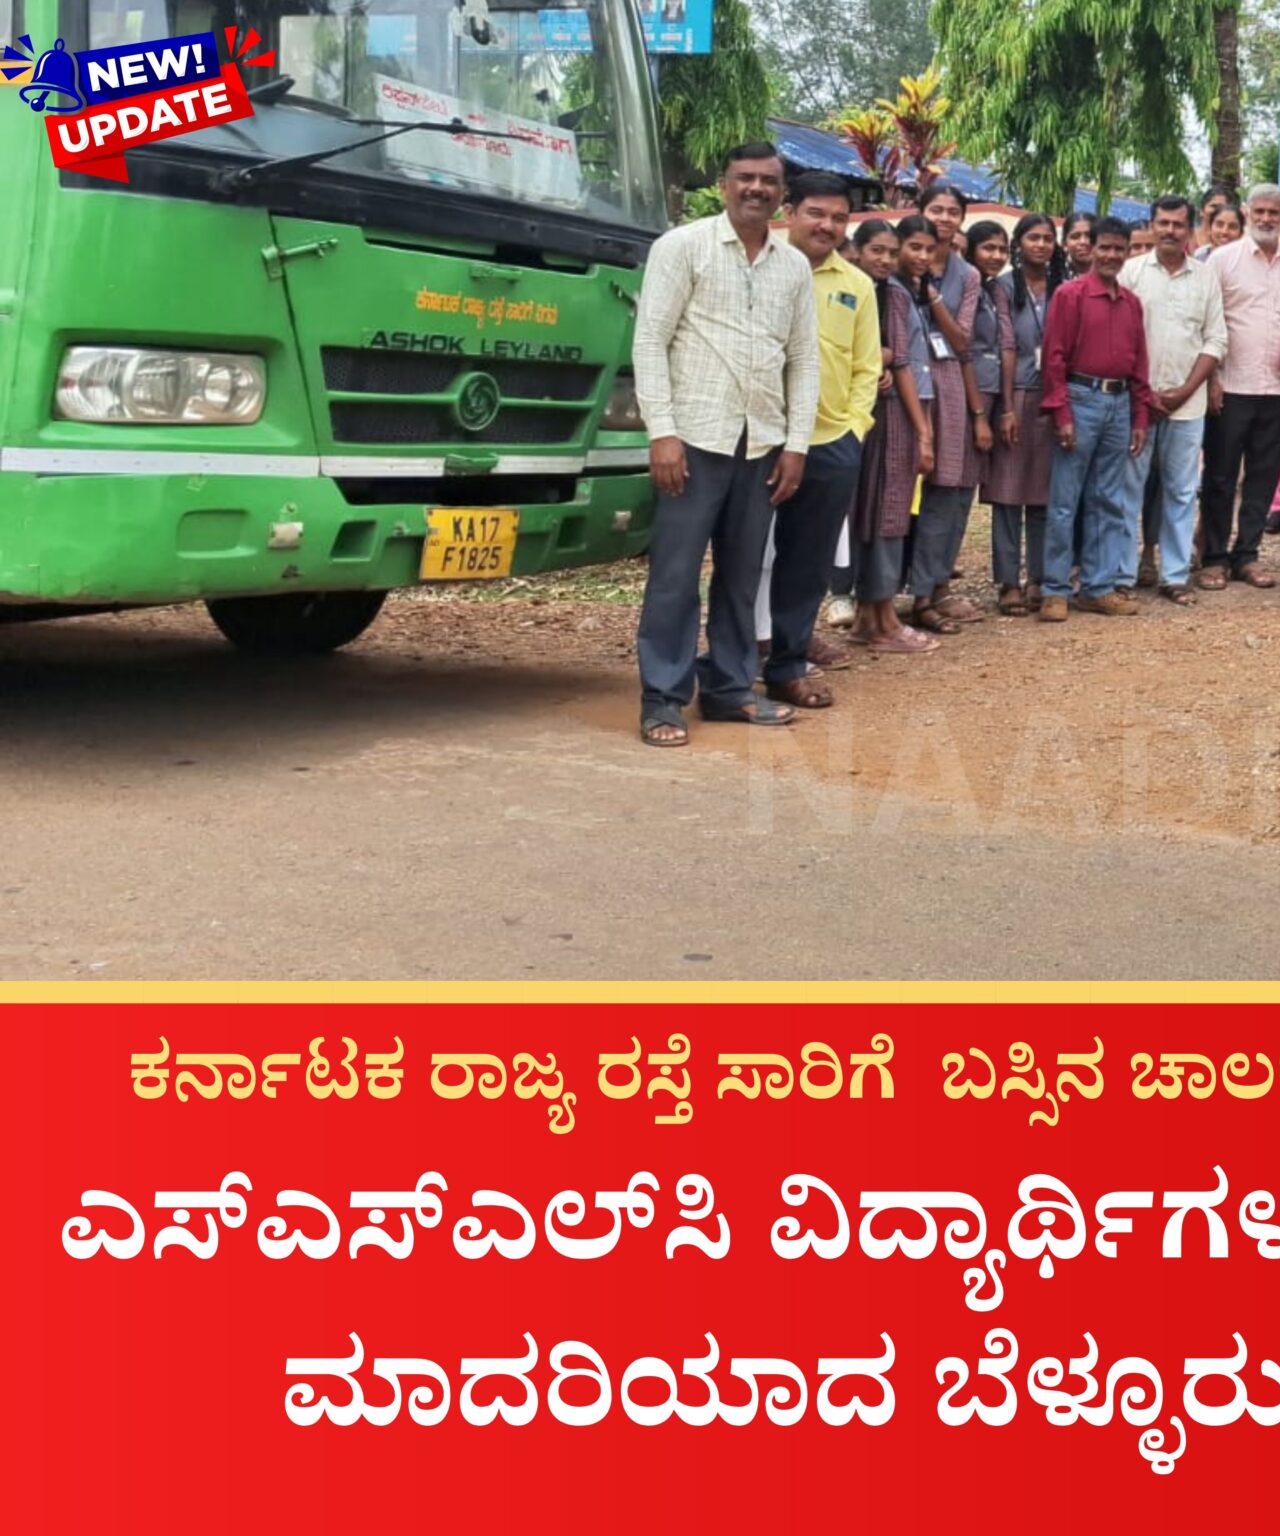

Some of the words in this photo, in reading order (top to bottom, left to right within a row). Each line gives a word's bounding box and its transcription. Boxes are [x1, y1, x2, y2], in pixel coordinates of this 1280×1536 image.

[369, 330, 466, 354] ASHOK
[480, 338, 583, 362] LEYLAND
[441, 546, 503, 572] F1825
